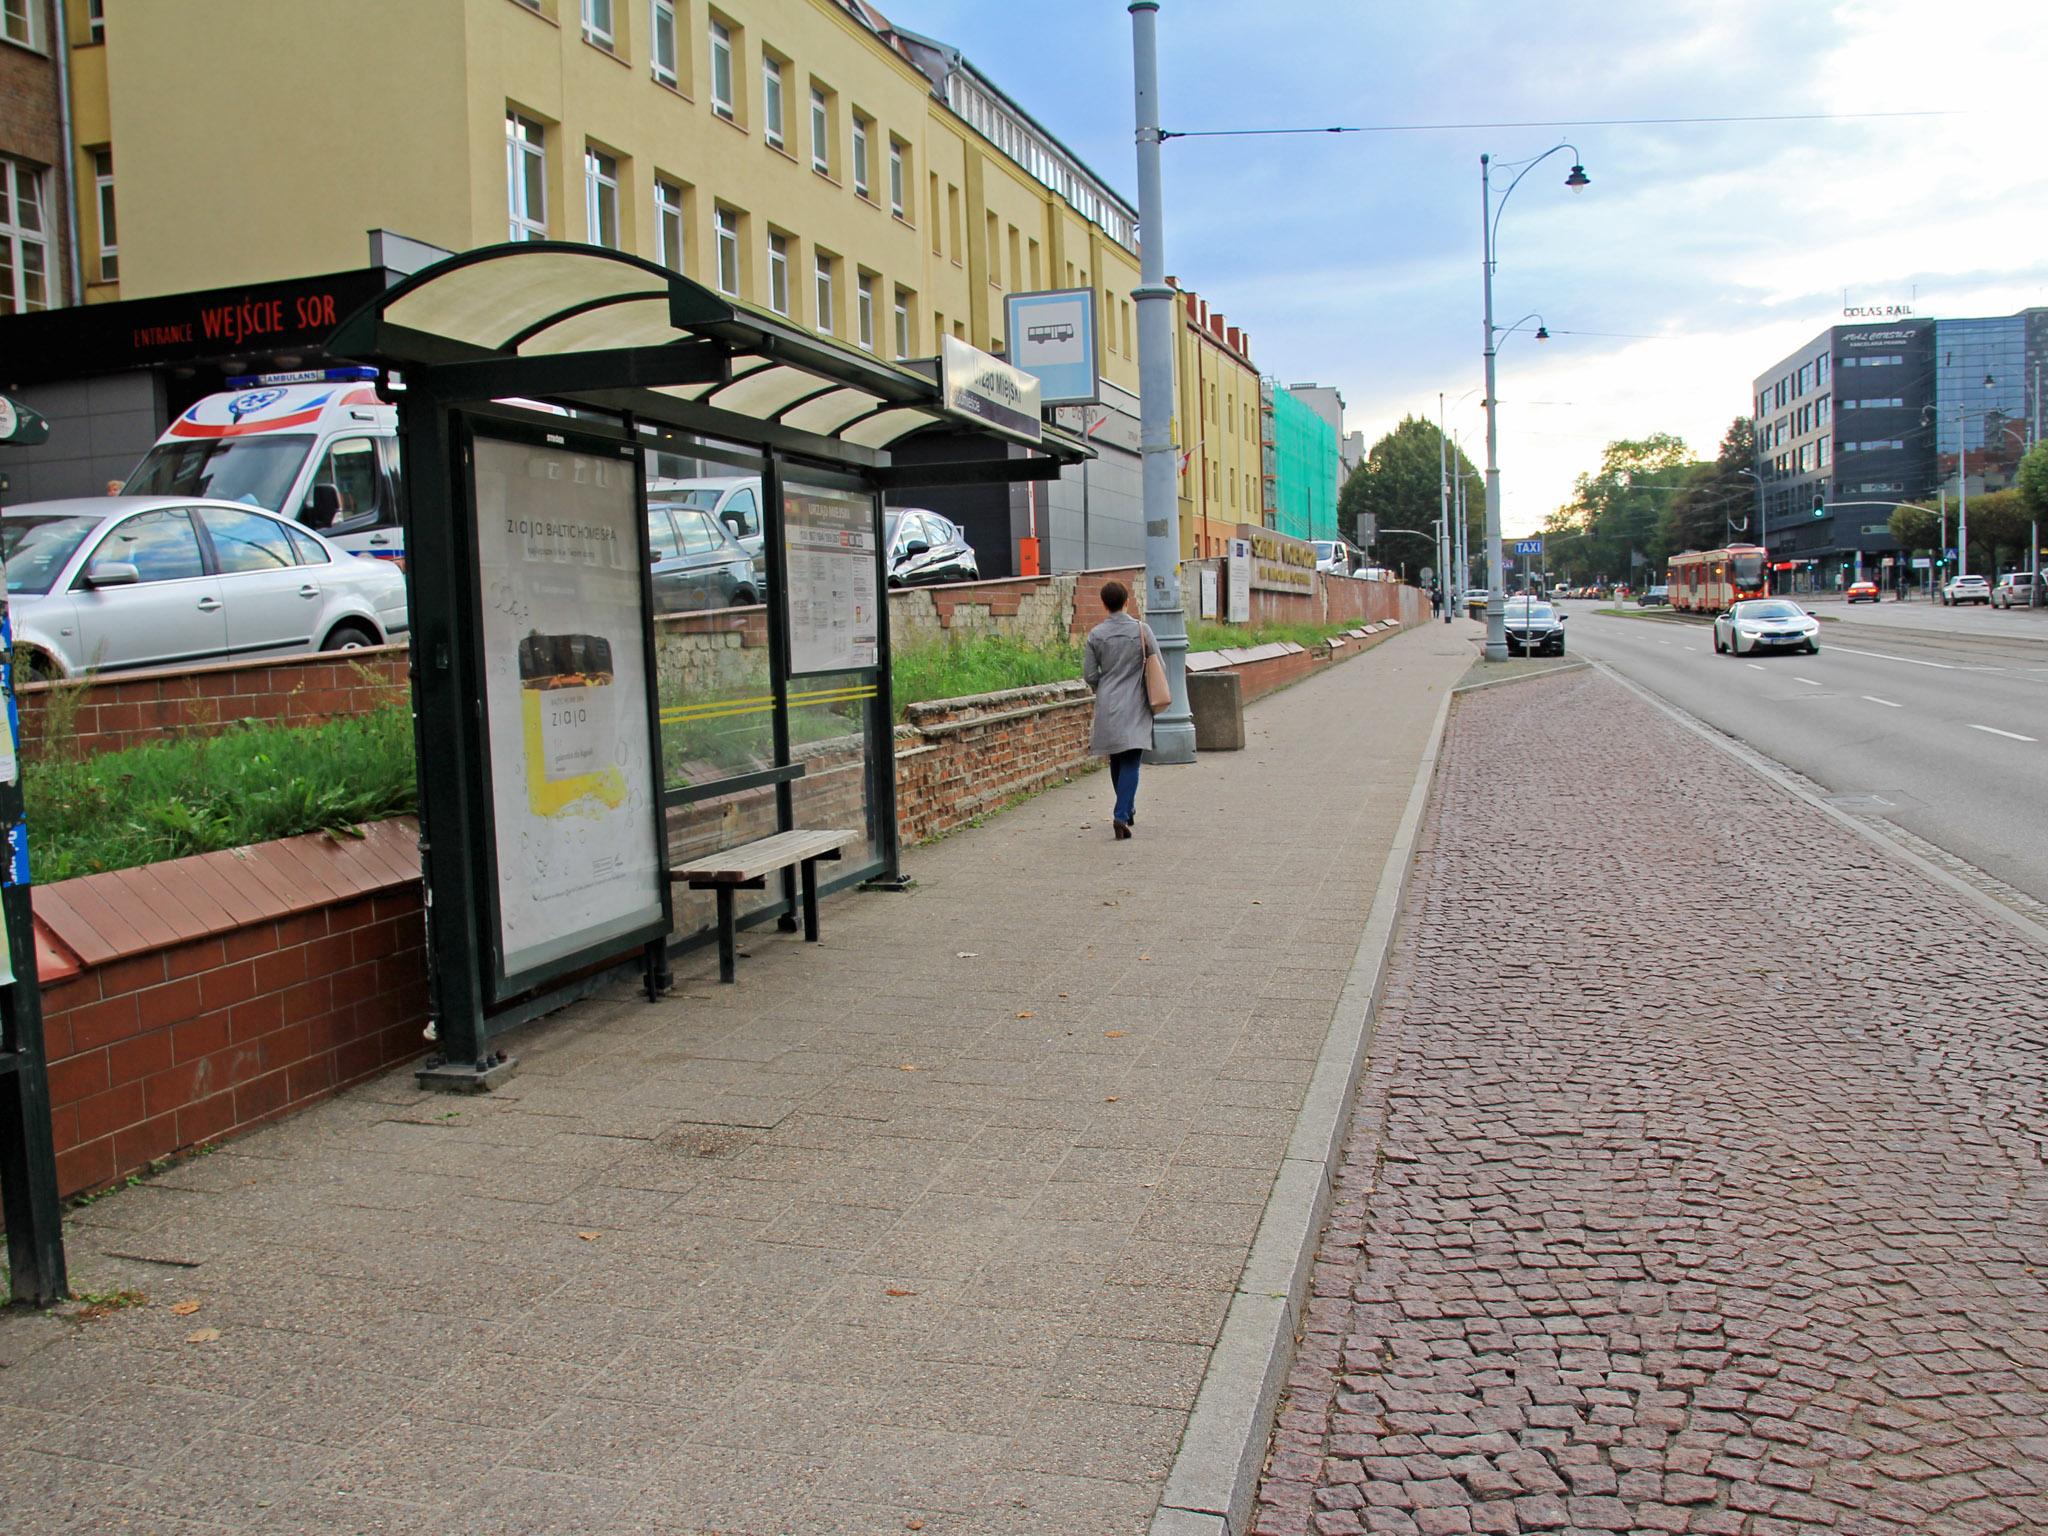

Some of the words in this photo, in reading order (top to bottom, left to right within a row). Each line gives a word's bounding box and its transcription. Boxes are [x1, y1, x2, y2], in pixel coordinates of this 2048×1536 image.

[1843, 307, 1882, 317] COLAS
[1886, 305, 1912, 315] RAIL
[134, 323, 193, 347] ENTRANCE
[202, 296, 284, 344] WEJŚCIE
[297, 295, 336, 328] SOR
[266, 373, 317, 383] AMBULANS
[1517, 543, 1540, 553] TAXI
